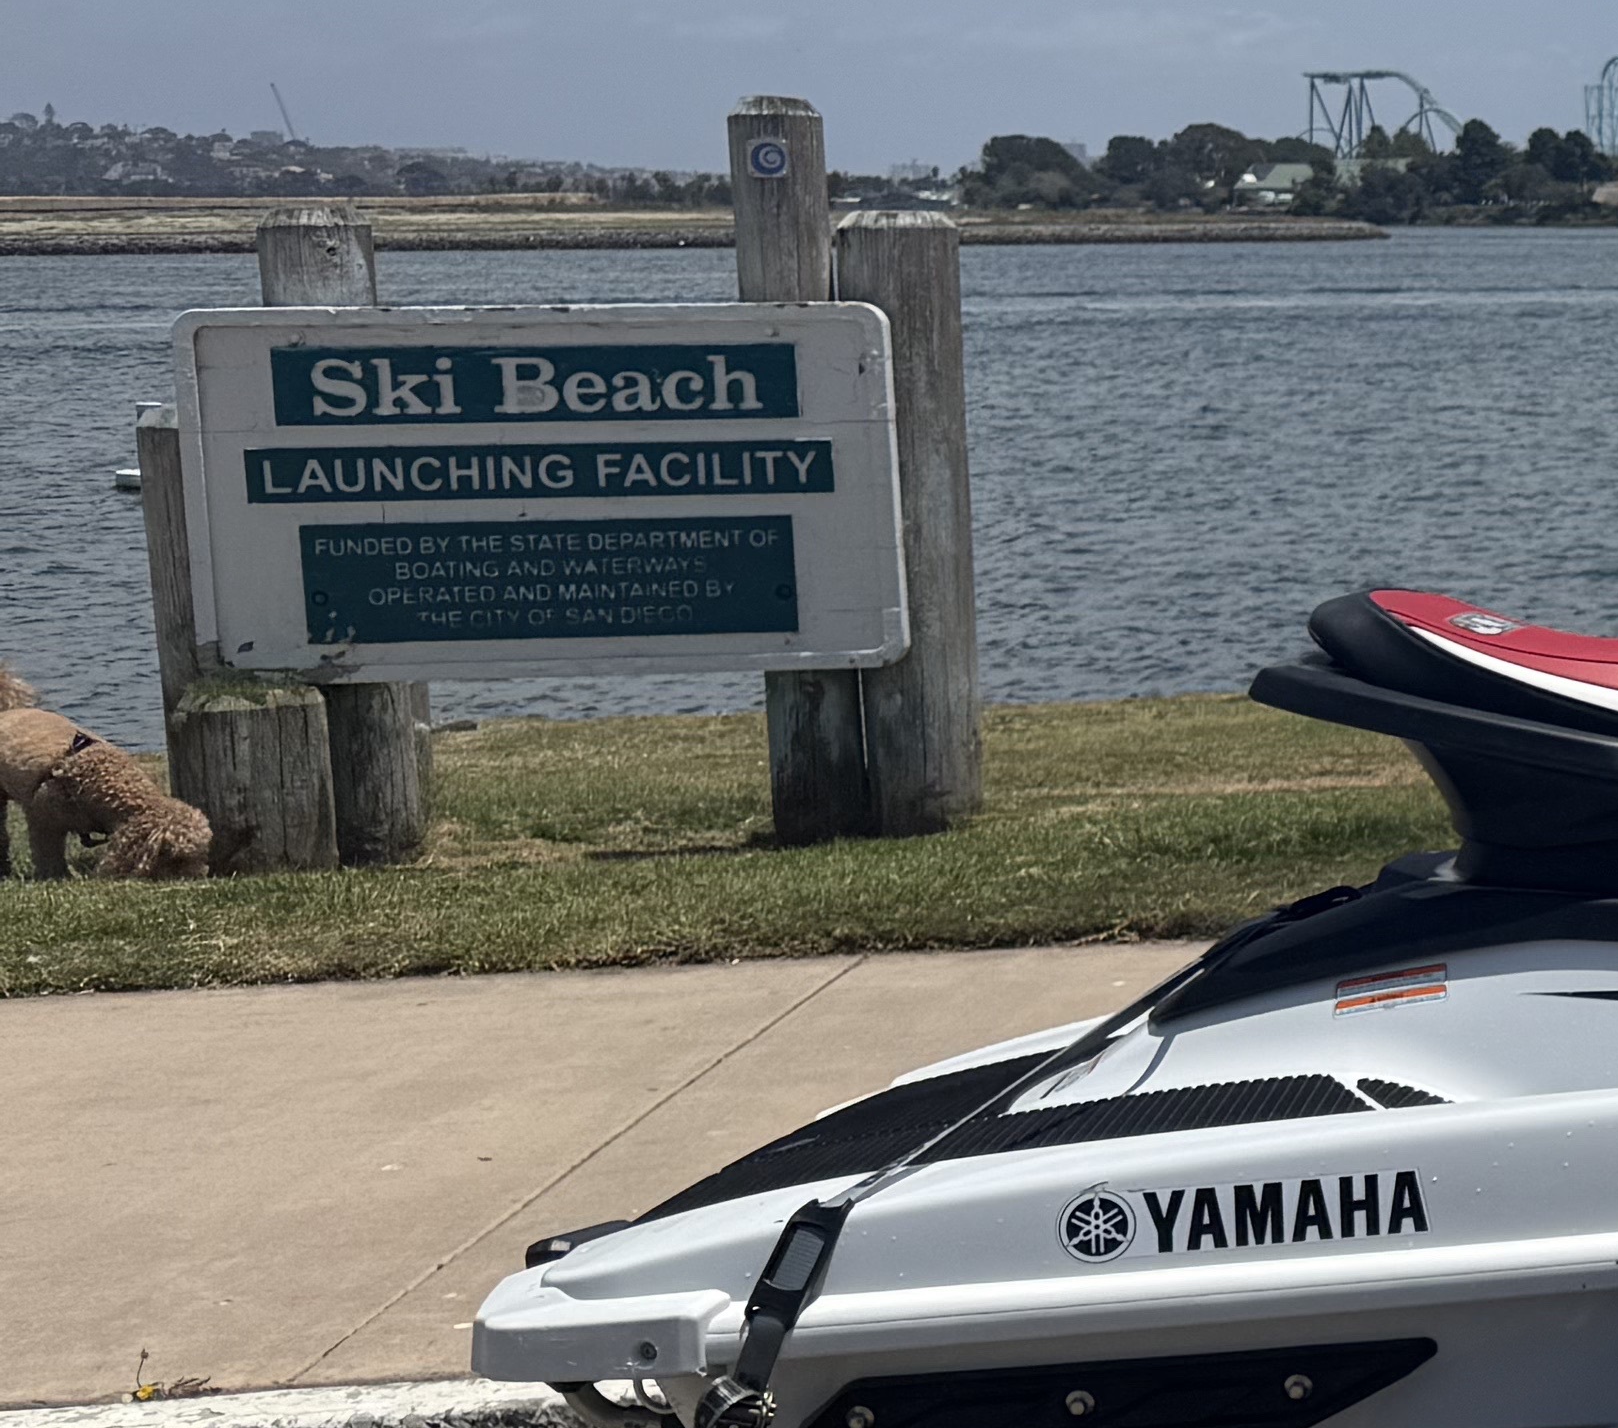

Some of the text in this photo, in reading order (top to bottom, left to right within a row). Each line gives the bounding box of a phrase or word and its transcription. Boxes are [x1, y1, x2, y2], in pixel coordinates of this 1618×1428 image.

[310, 355, 764, 417] Ski Beach
[262, 451, 817, 494] LAUNCHING FACILITY
[315, 529, 779, 556] FUNDED BY THE STATE DEPARTMENT OF
[395, 556, 707, 580] BOATING AND WATERWAYS
[368, 579, 735, 605] OPERATED AND MAINTAINED BY
[417, 610, 462, 628] THE
[470, 607, 519, 626] CITY
[527, 608, 553, 625] OF
[566, 606, 612, 624] SAN
[1143, 1170, 1428, 1253] YAMAHA
